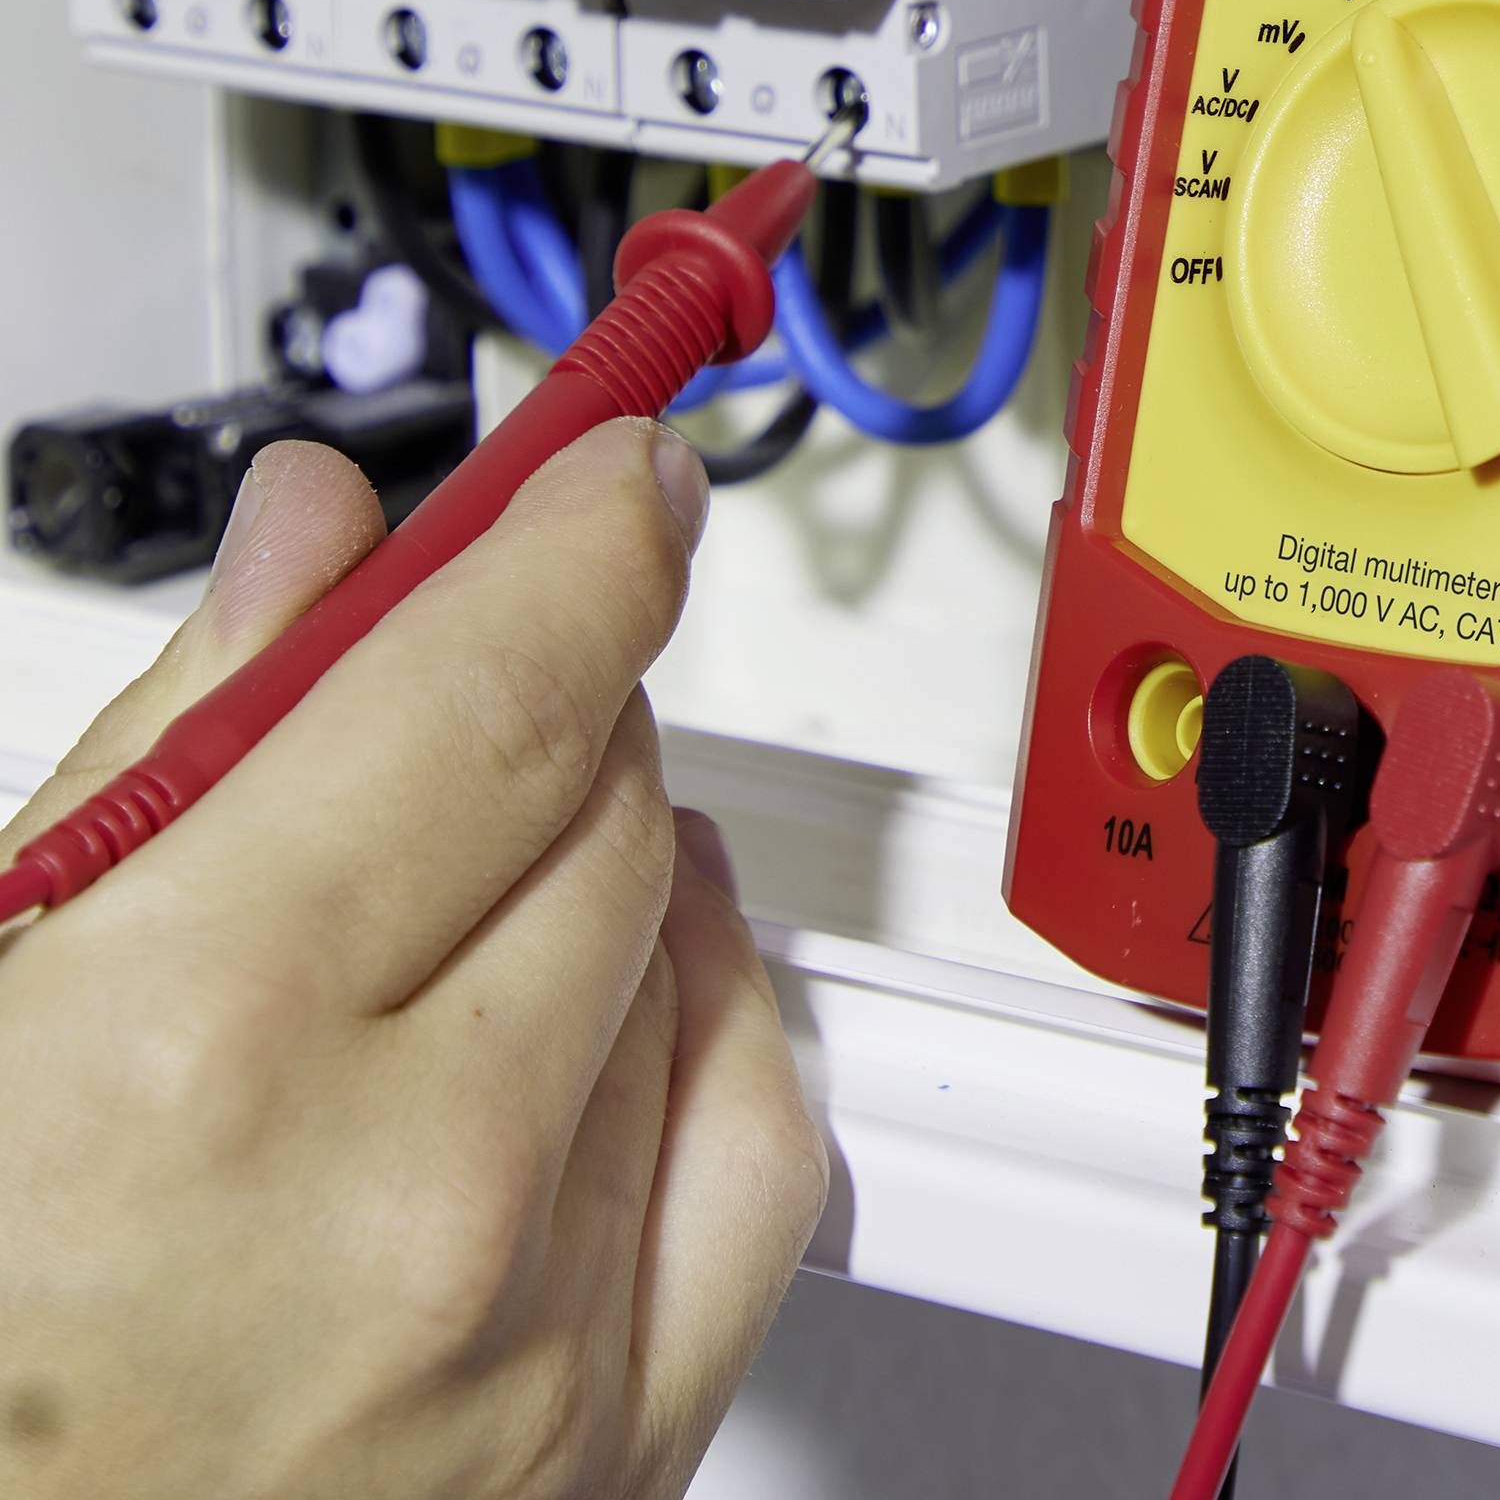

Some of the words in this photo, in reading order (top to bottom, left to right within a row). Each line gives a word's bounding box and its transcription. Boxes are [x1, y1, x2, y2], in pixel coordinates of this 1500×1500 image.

[1258, 19, 1300, 45] mV
[1222, 68, 1240, 93] V
[1191, 95, 1251, 119] AC/DC
[1202, 150, 1218, 175] V
[1174, 176, 1223, 199] SCAN
[1170, 257, 1215, 285] OFF
[1278, 534, 1357, 573] Digital
[1224, 571, 1257, 601] up
[1264, 575, 1289, 603] to
[1300, 580, 1368, 619] 1,000
[1376, 595, 1395, 622] V
[1399, 601, 1446, 640] AC,
[1103, 815, 1154, 862] 10A
